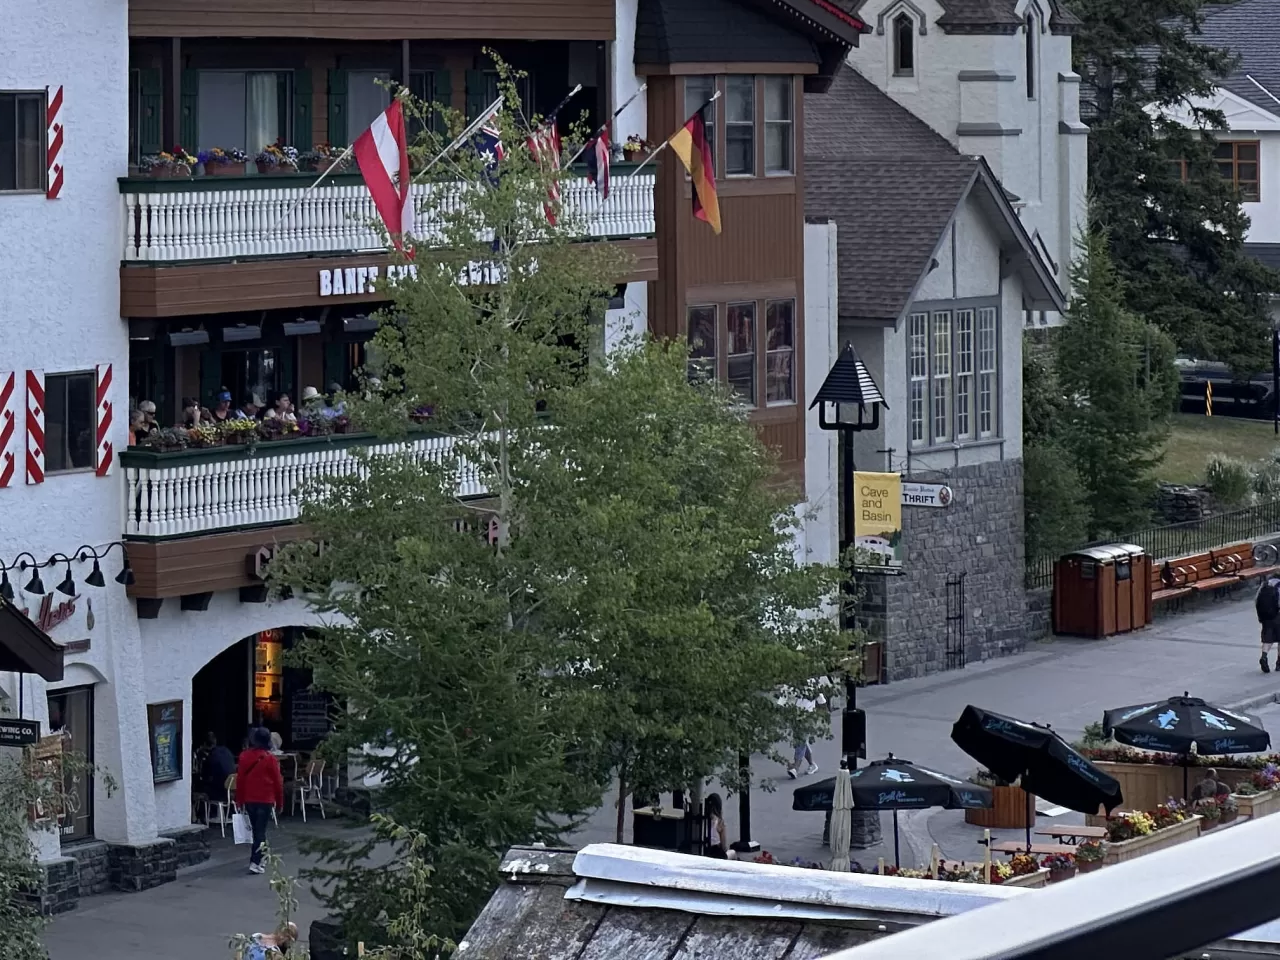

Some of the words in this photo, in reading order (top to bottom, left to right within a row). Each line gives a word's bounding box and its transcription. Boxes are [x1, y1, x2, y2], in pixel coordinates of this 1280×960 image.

[320, 266, 378, 297] BANFF
[861, 486, 889, 498] Cave
[862, 499, 882, 509] and
[902, 493, 935, 504] THRIFT
[862, 510, 892, 522] Basin
